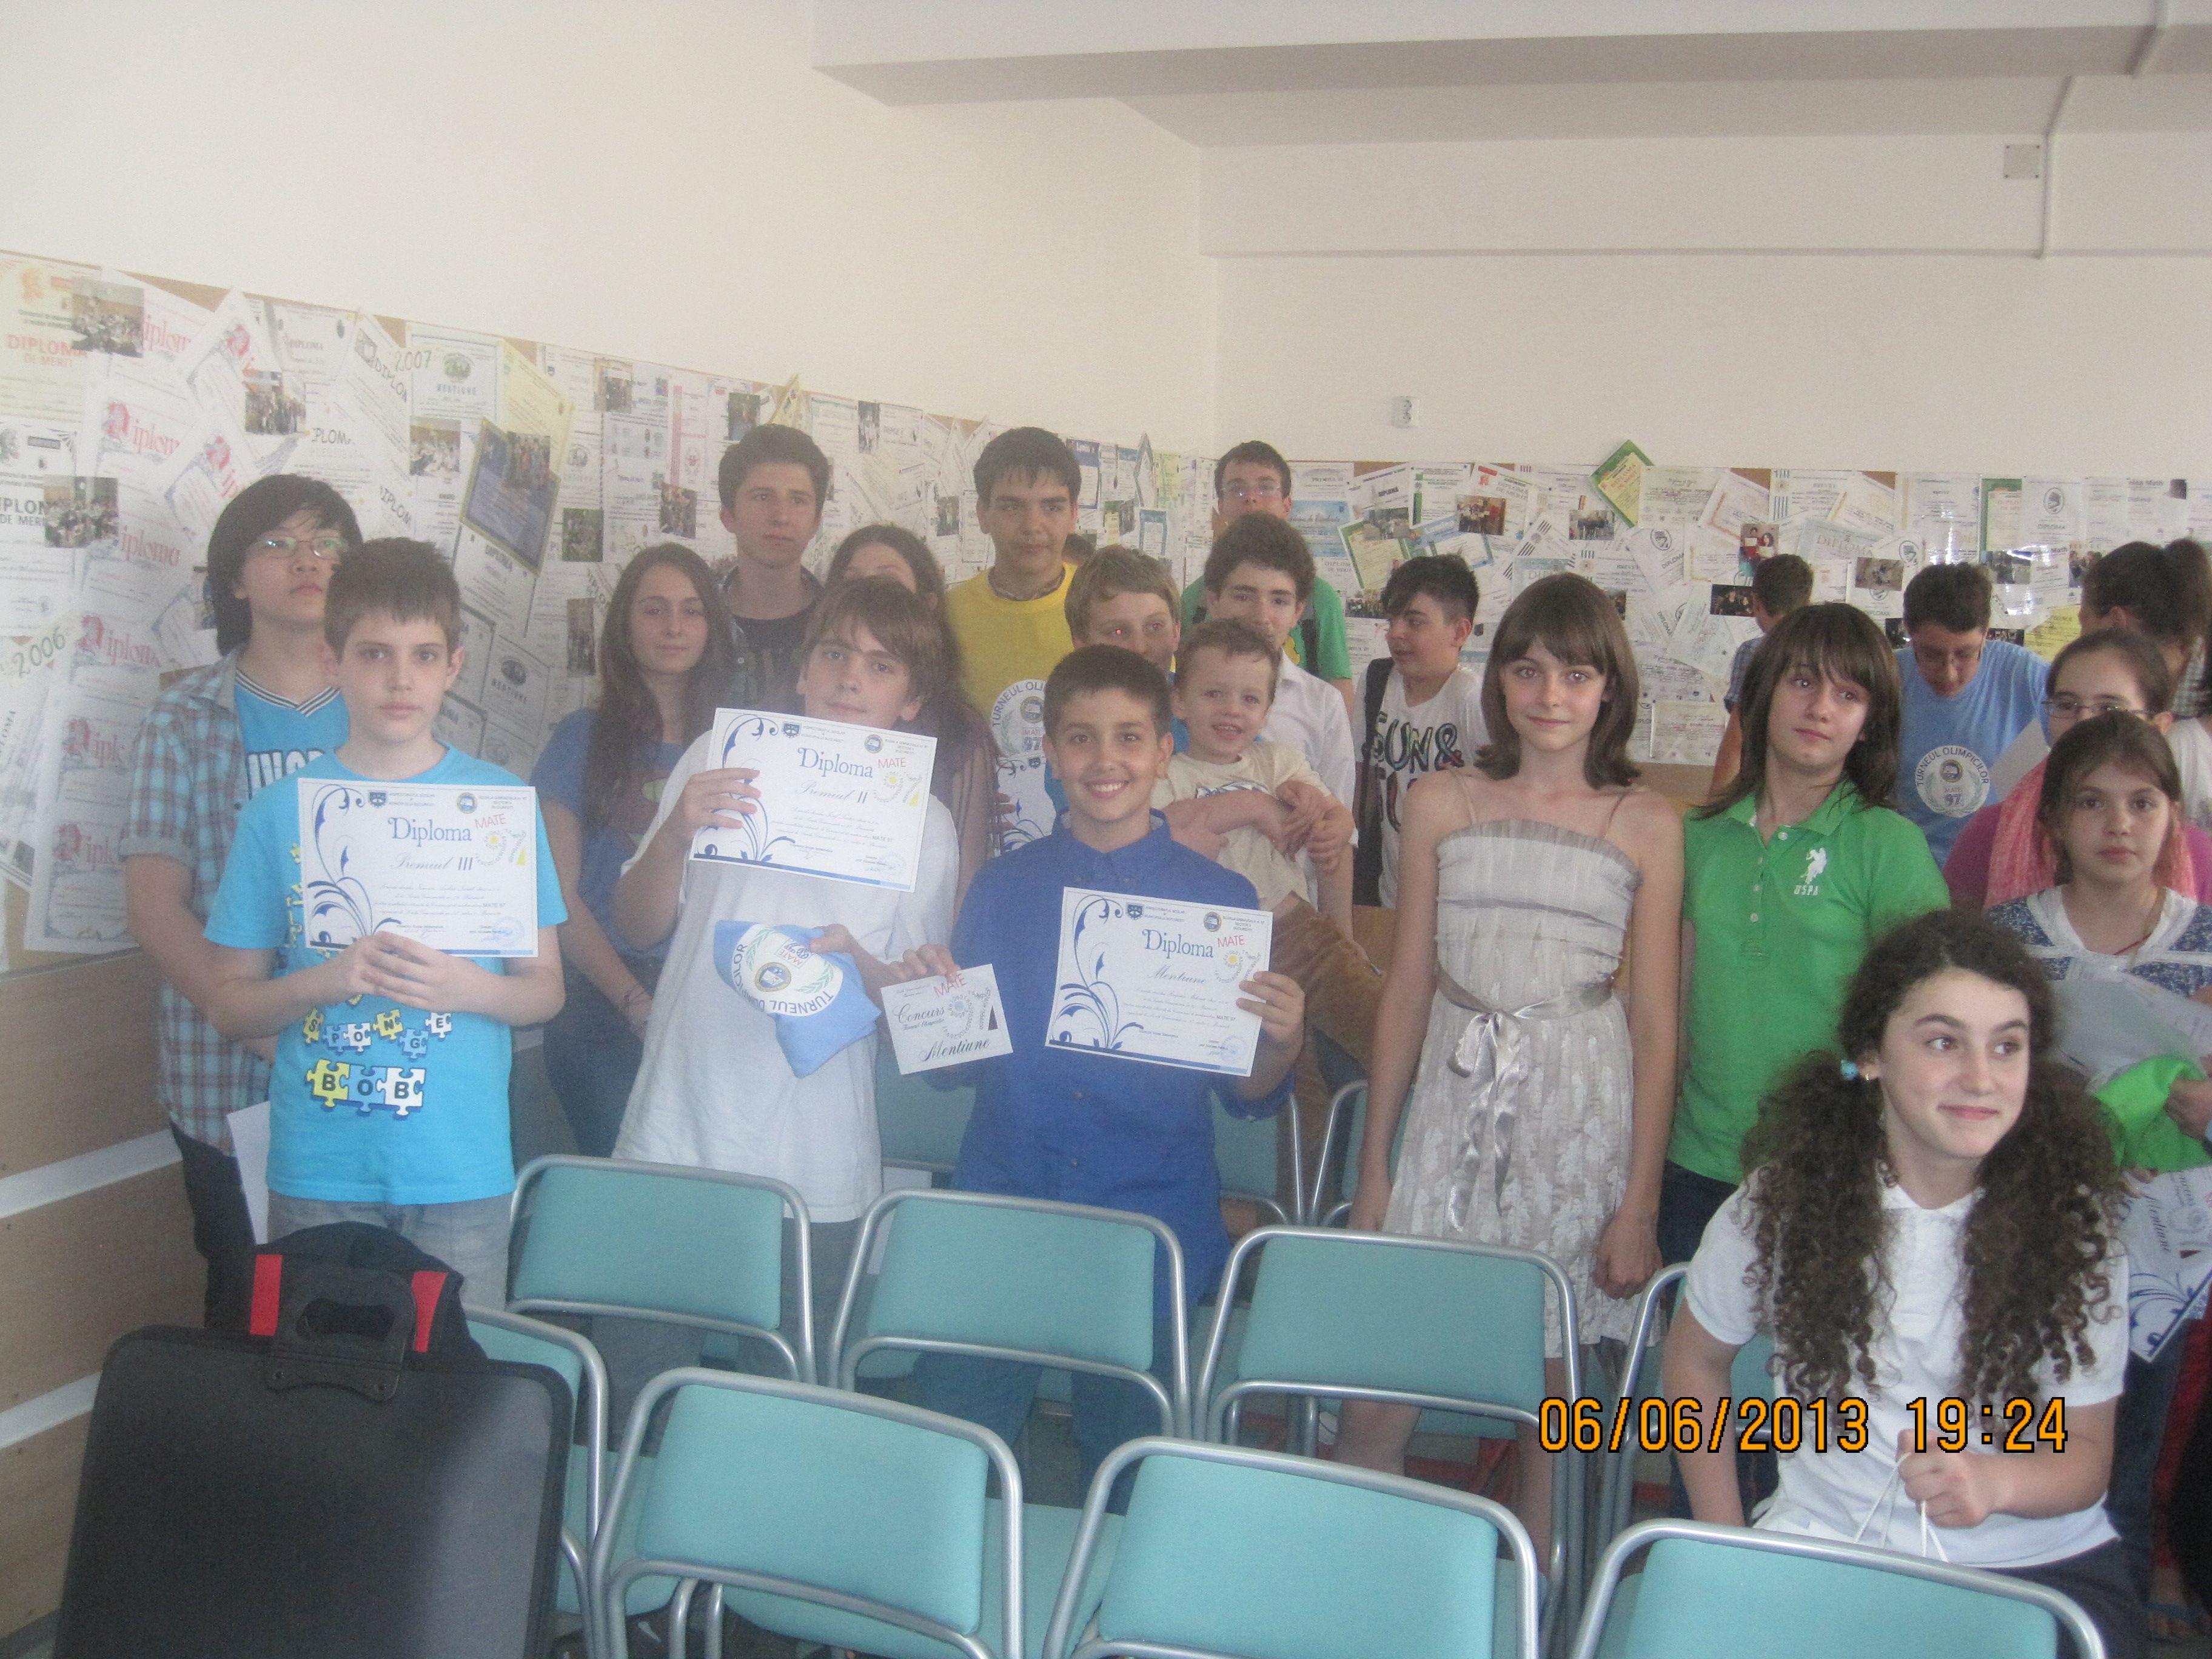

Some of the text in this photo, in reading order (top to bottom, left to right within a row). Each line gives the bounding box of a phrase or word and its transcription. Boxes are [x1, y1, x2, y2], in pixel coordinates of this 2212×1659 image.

[394, 349, 432, 372] 2007
[12, 626, 65, 679] 2006
[992, 684, 1024, 727] TURNEUL
[797, 746, 873, 779] Diploma
[877, 757, 906, 769] MATE
[1917, 747, 1989, 786] TURNEUL OLIMPICILOR
[1945, 793, 1962, 806] 97
[387, 816, 472, 847] Diploma
[474, 813, 506, 830] MATE
[457, 856, 474, 871] III
[1794, 885, 1819, 896] USPA
[1142, 928, 1213, 959] Diploma
[1217, 934, 1245, 948] MATE
[777, 949, 803, 965] MATE
[933, 973, 968, 998] MATE
[768, 990, 834, 1014] TURNEUL
[893, 1002, 945, 1024] Concurs
[919, 1037, 991, 1062] Mentiune
[322, 1073, 409, 1099] BOB
